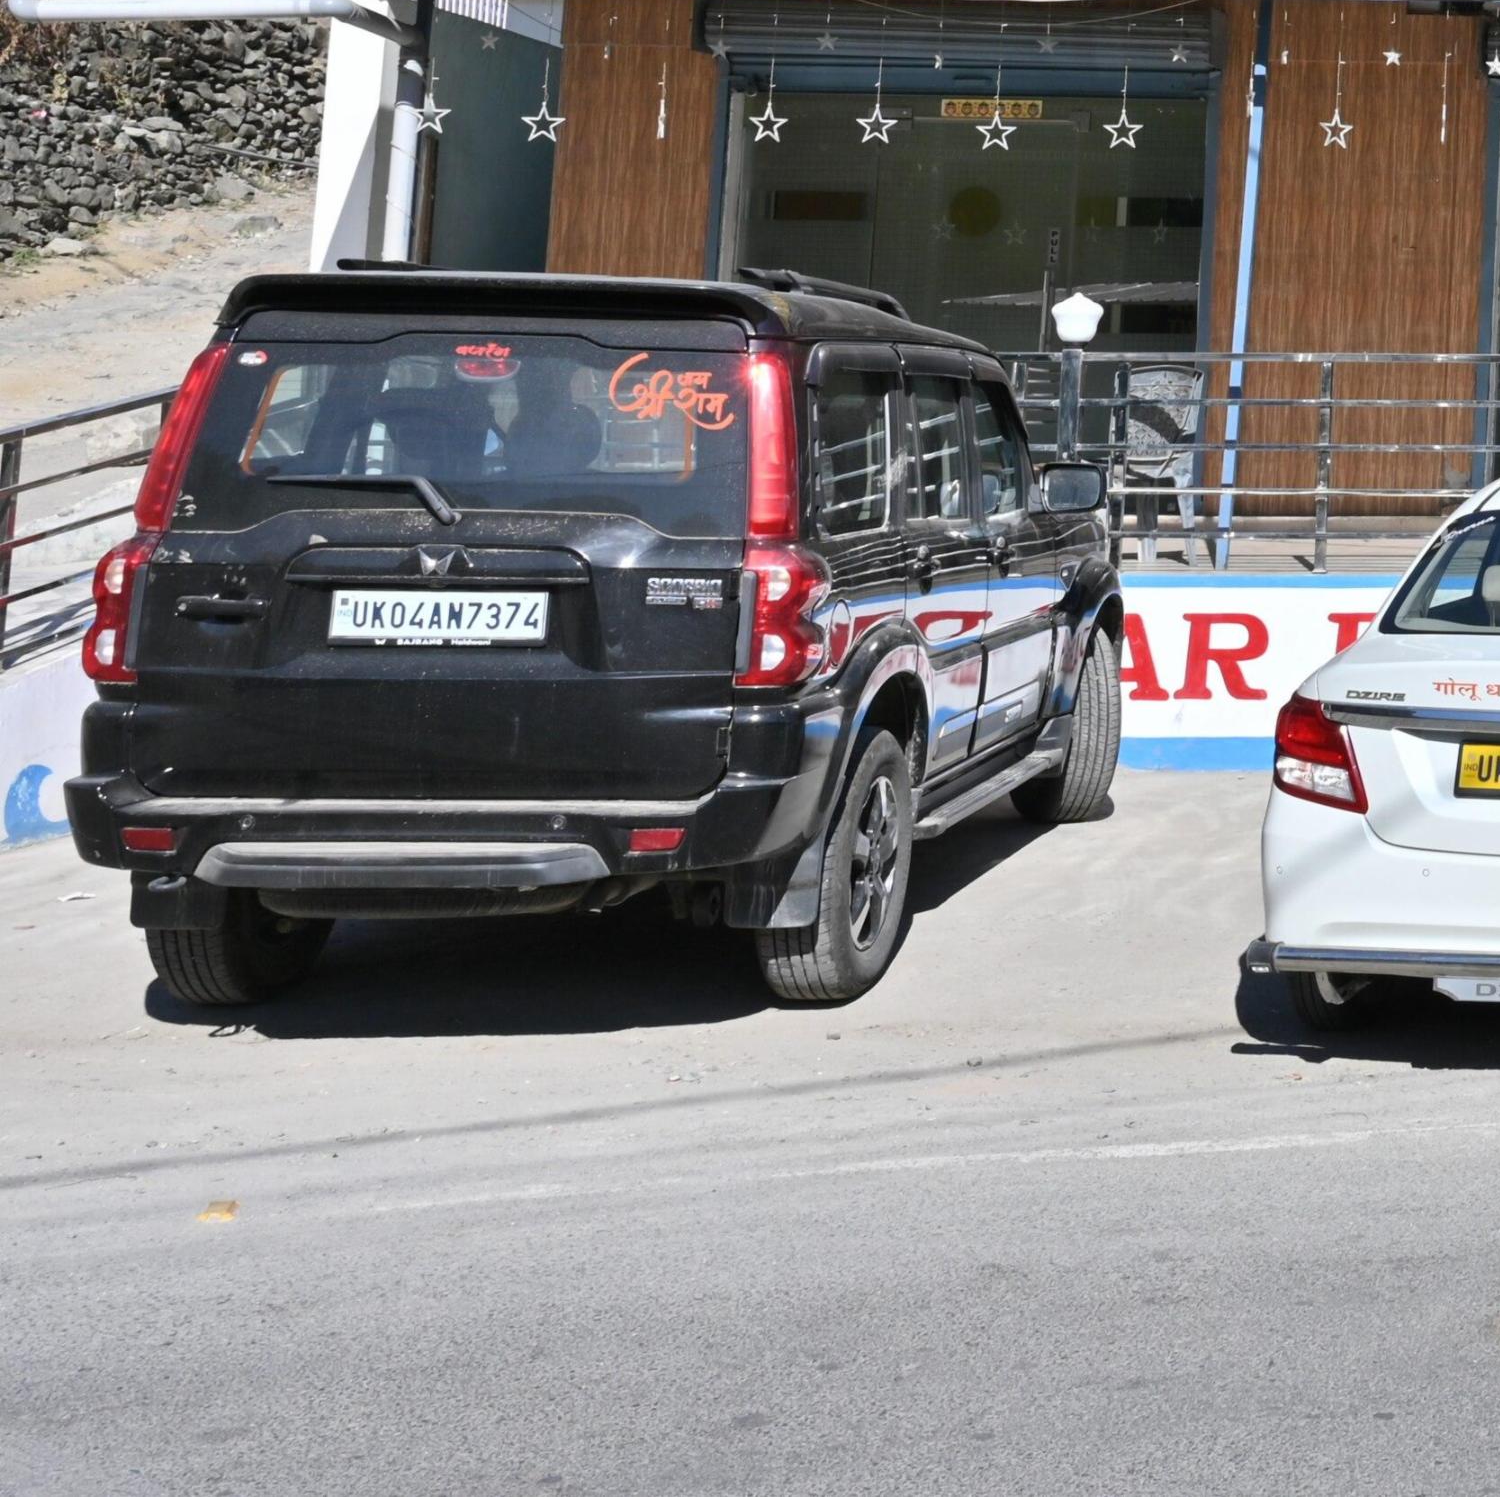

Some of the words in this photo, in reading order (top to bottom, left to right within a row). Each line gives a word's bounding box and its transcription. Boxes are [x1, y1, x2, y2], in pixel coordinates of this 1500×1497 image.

[1049, 229, 1060, 264] PULL
[647, 576, 722, 596] SCORPIO
[352, 600, 540, 631] UK04AN7374
[1119, 612, 1268, 701] AR
[1345, 689, 1406, 702] DZIRE
[1432, 677, 1482, 701] गोलू
